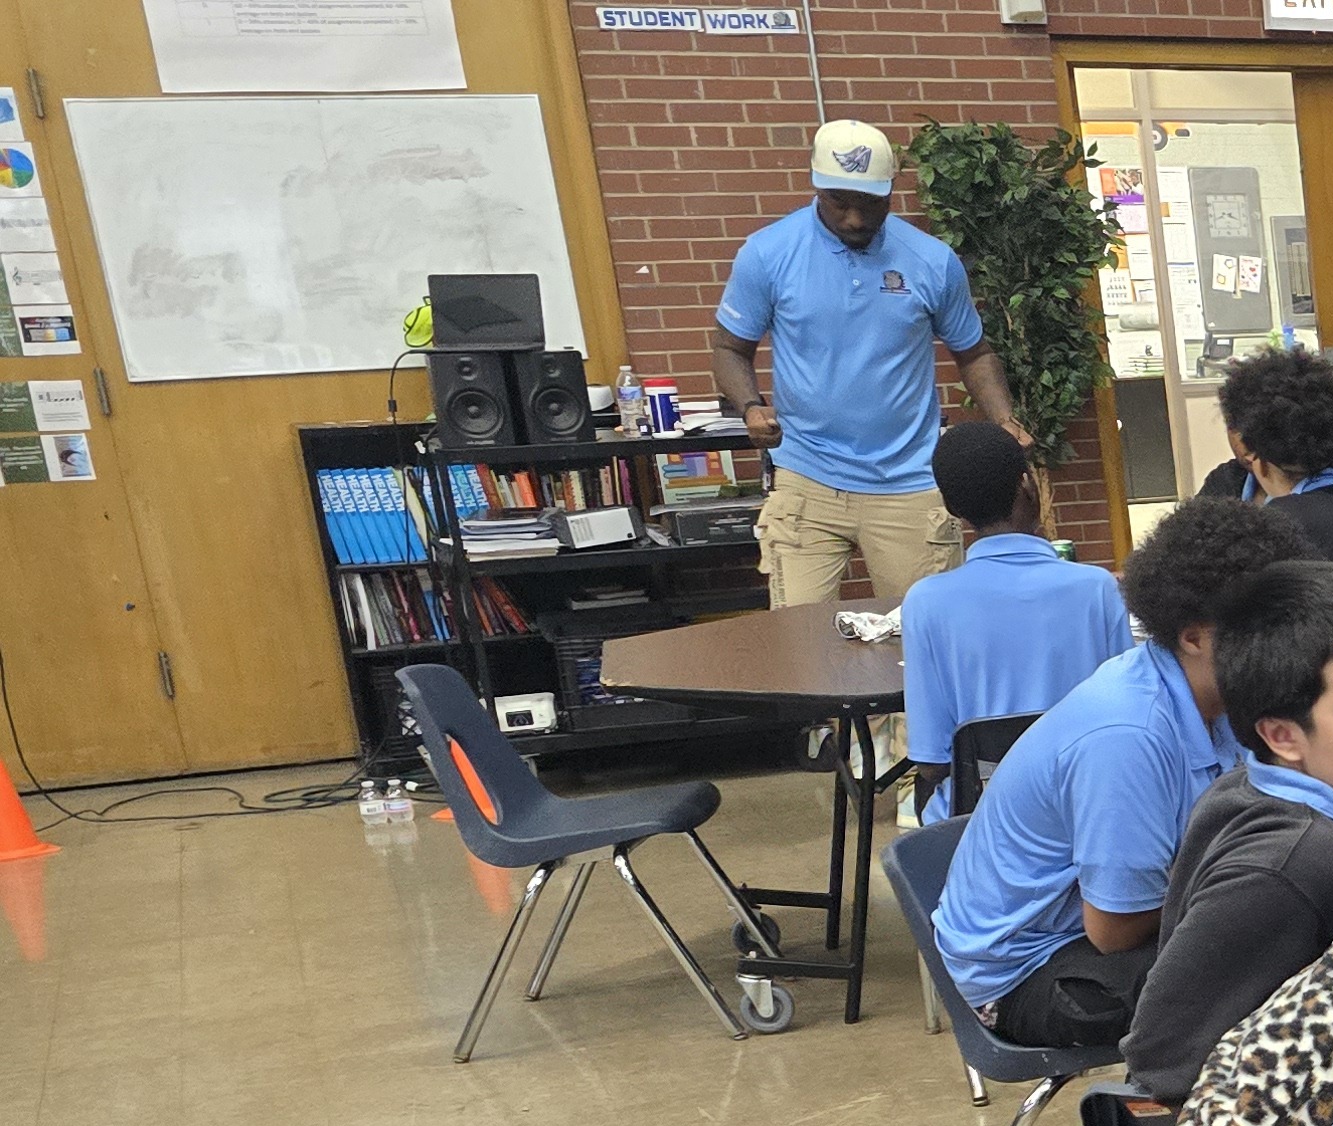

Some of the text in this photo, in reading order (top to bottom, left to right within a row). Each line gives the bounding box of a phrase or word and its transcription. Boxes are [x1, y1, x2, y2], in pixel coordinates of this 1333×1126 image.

[602, 11, 771, 29] STUDENT WORK
[467, 469, 489, 506] HEALTH
